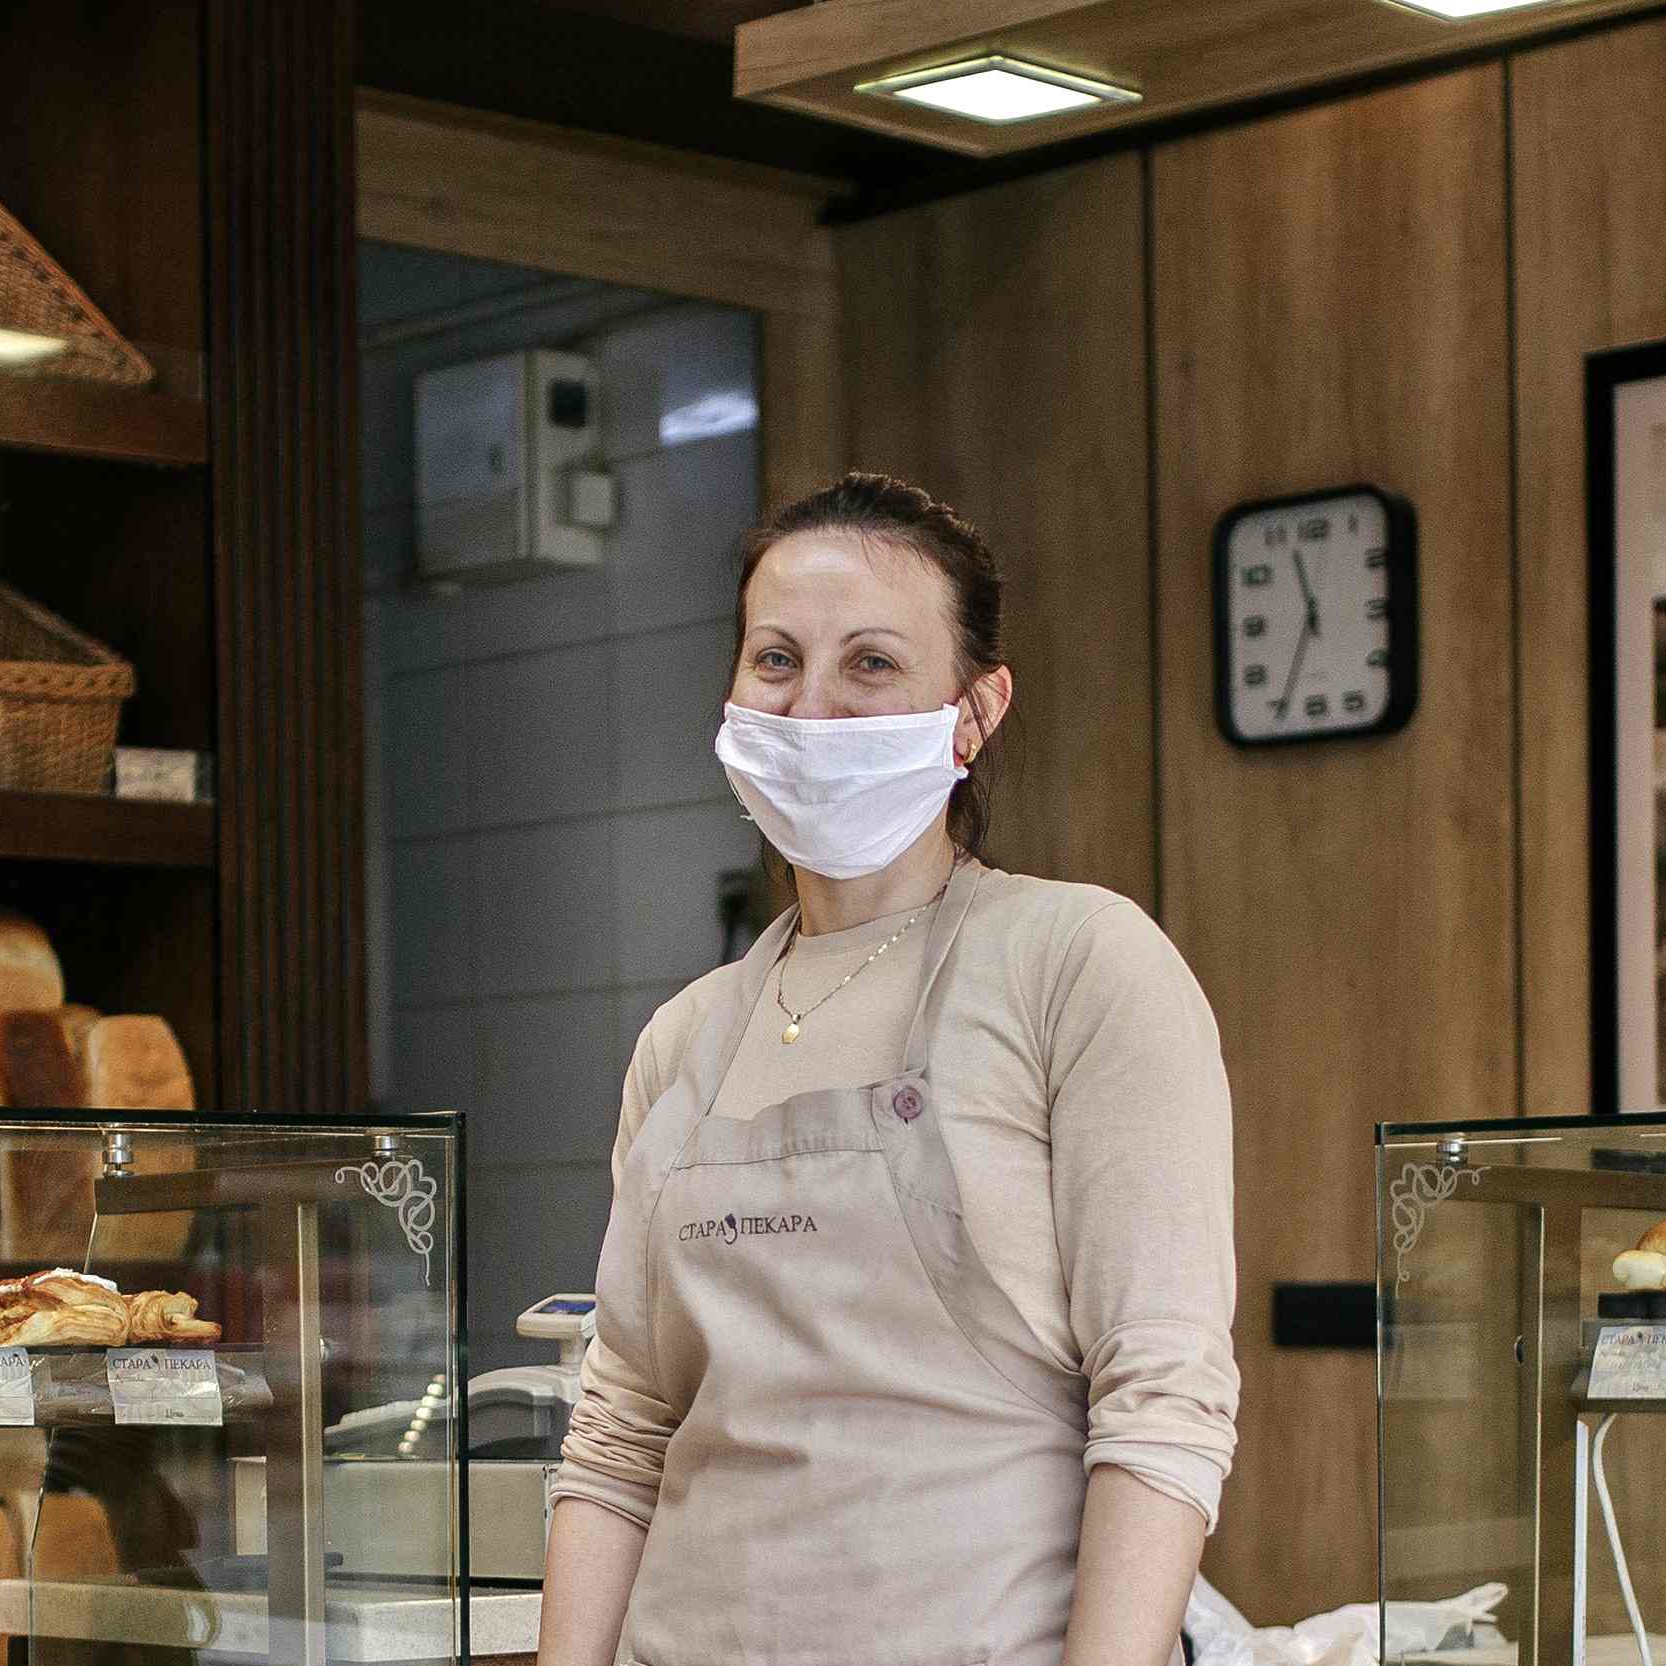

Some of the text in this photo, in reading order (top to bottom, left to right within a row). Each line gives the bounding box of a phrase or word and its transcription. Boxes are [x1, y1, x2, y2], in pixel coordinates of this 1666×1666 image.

[678, 1215, 818, 1241] СТАРА ПЕКАРА
[1601, 1334, 1635, 1345] СТАРА
[113, 1359, 211, 1370] СТАРА ПЕКАРА
